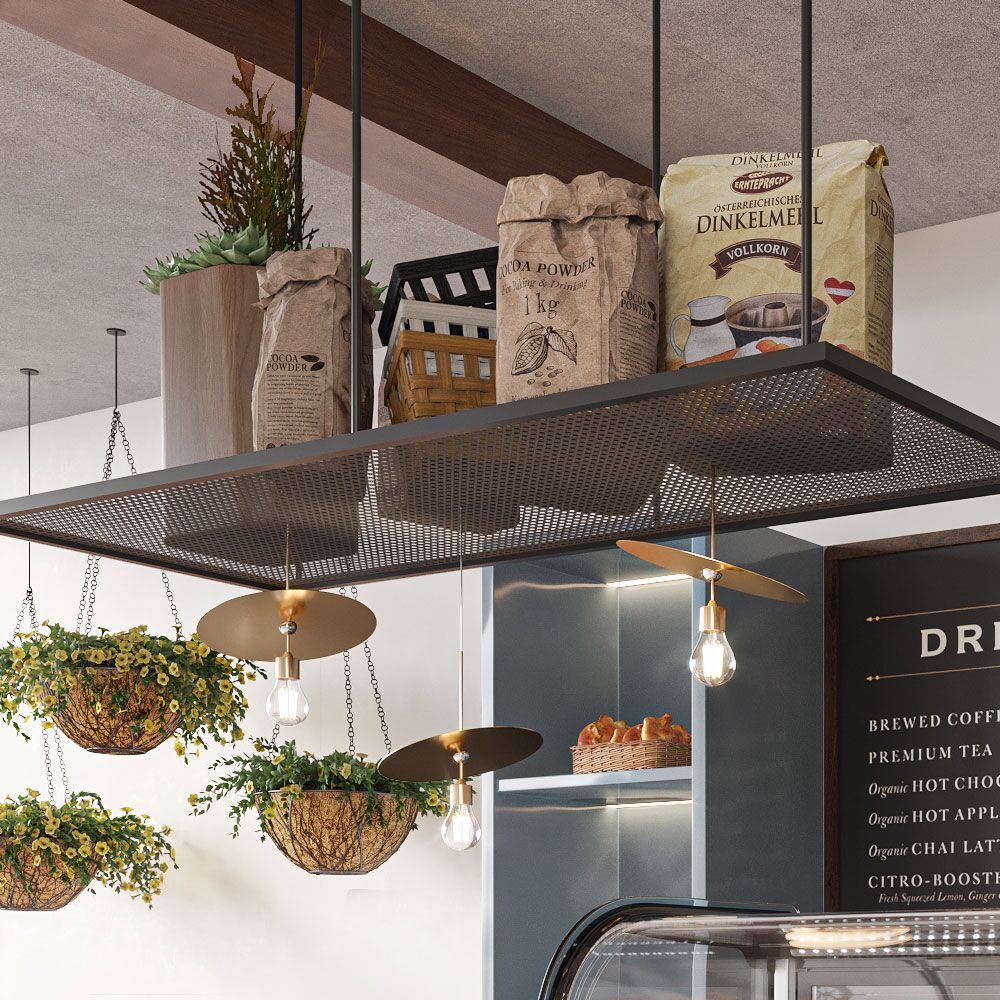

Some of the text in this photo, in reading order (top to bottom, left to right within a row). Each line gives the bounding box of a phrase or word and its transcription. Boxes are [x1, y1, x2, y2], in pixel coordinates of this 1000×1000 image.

[731, 148, 824, 166] DINKELMEL
[713, 195, 803, 213] ÖSTERREICHISCHE
[726, 243, 790, 260] VOLLKORN
[536, 256, 596, 277] POWDER
[524, 292, 560, 319] 1 kg
[620, 290, 647, 308] COCOA
[620, 298, 651, 320] POWDER
[266, 363, 308, 372] POWDER
[869, 714, 942, 732] BREWED
[869, 743, 993, 764] PREMIUM TEA
[868, 780, 908, 799] Organic
[912, 778, 950, 793] HOT
[868, 811, 908, 829] Organic
[912, 808, 950, 823] HOT
[868, 843, 908, 861] Organic
[911, 841, 955, 855] CHAI
[878, 893, 899, 903] Fresh
[901, 892, 935, 906] Squeezed
[938, 891, 966, 902] Lemon,
[968, 890, 996, 903] Ginger
